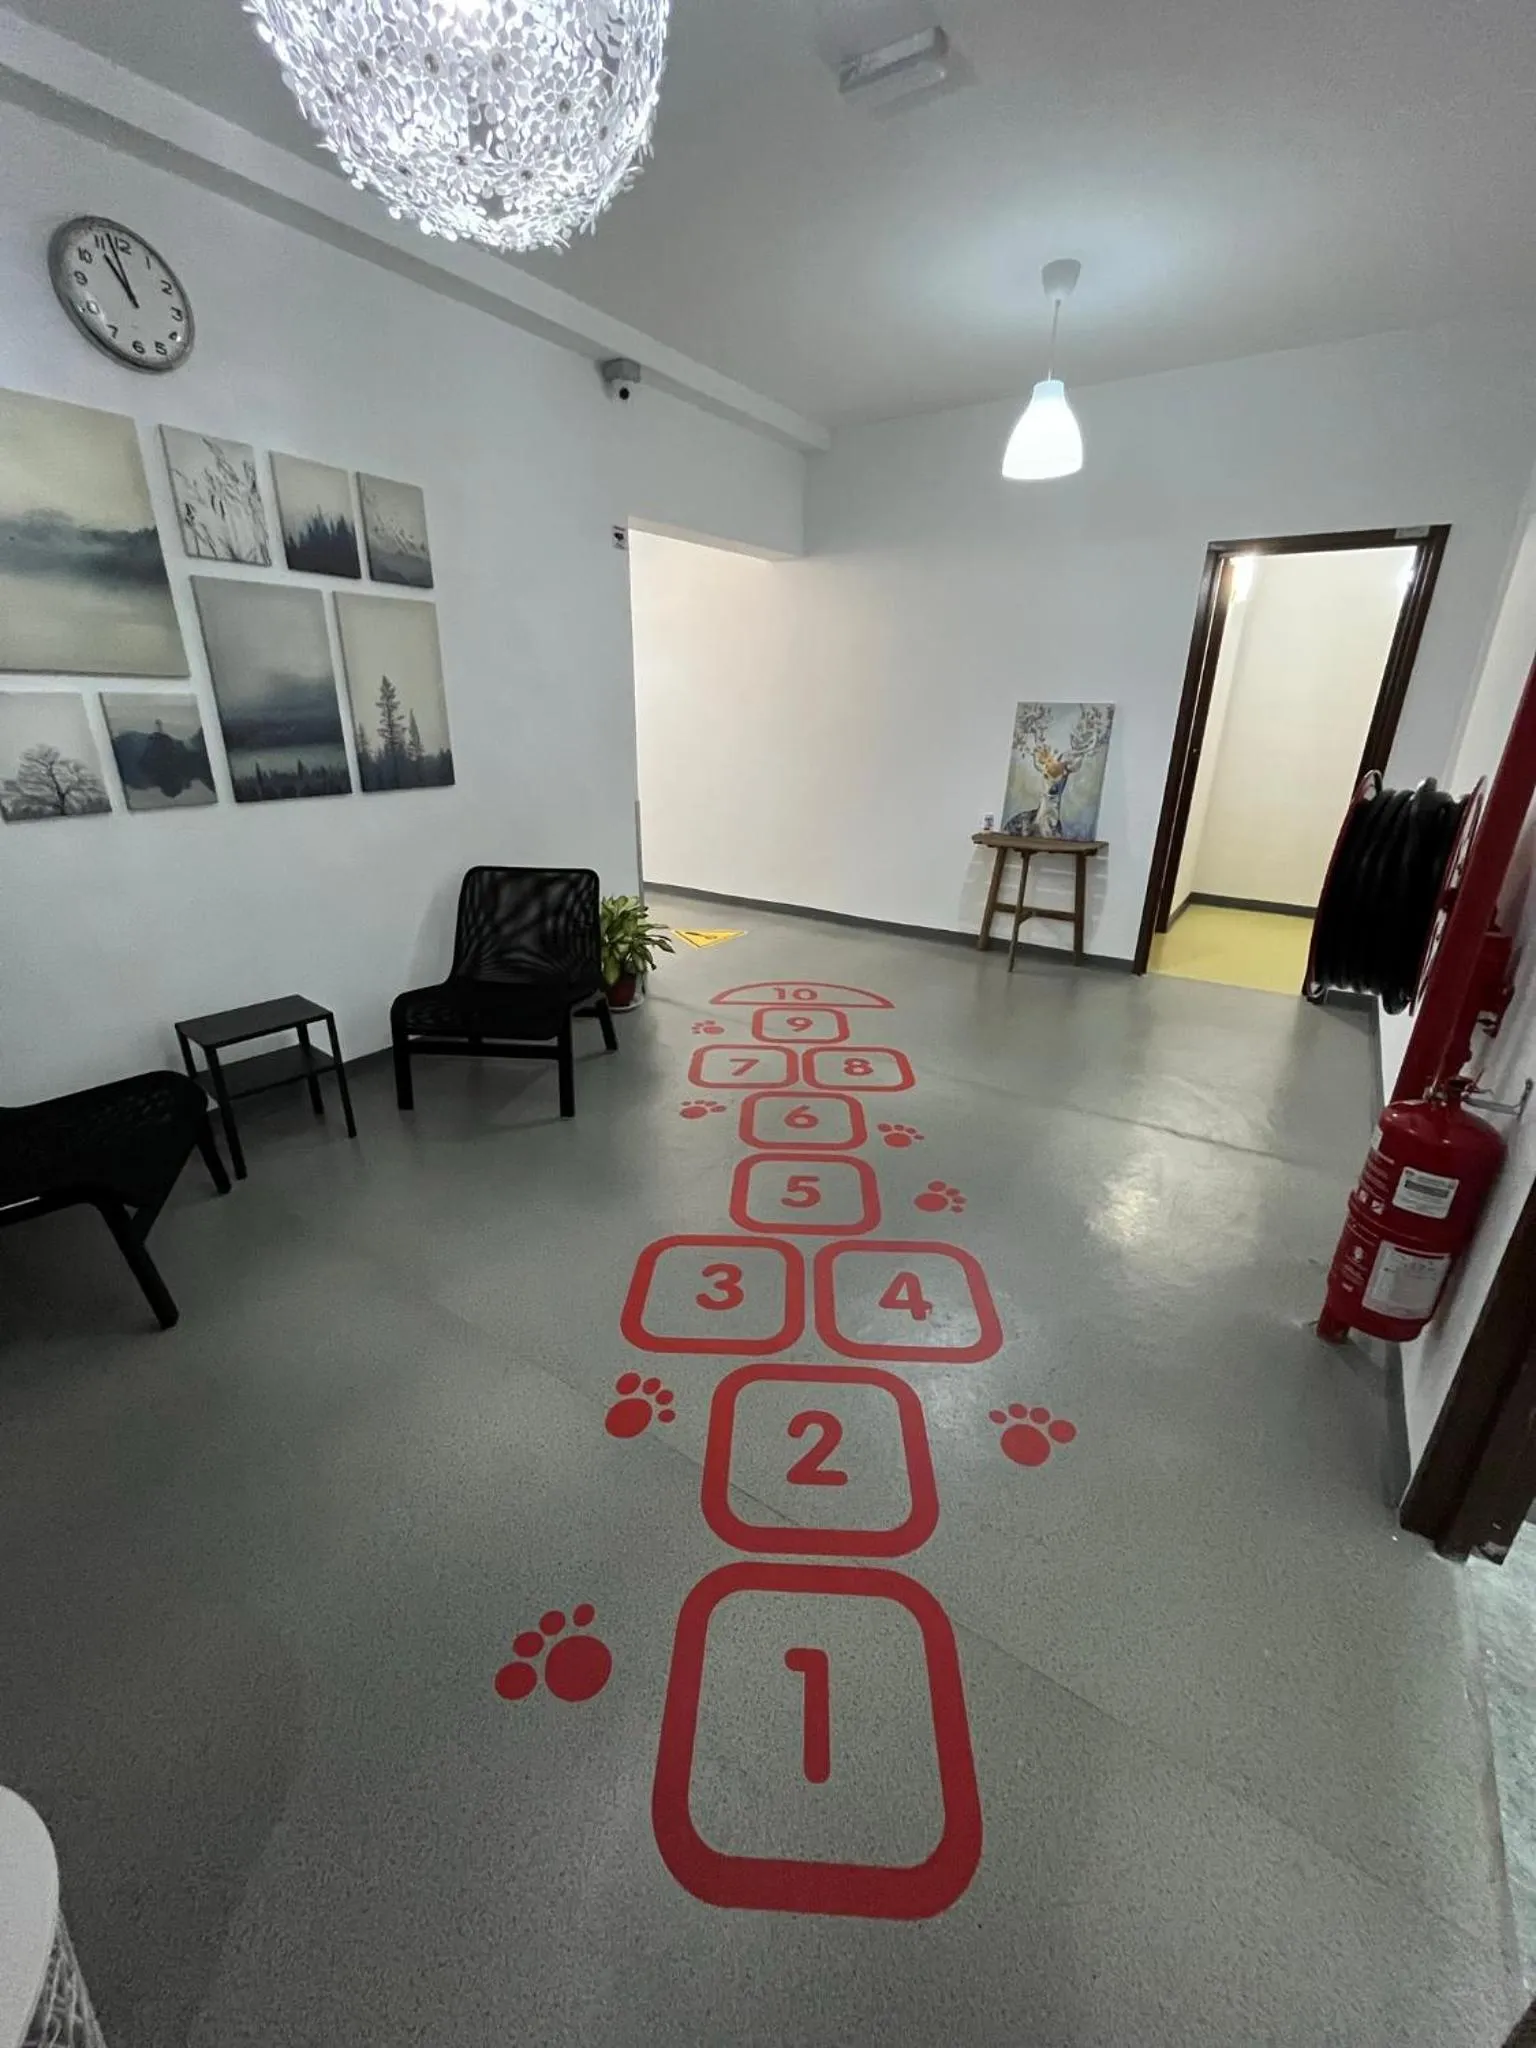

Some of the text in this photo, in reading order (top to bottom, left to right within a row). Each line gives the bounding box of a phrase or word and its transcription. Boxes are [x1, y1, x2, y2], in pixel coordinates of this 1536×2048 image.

[115, 236, 132, 255] 12
[78, 247, 93, 264] 10
[145, 256, 151, 270] 1
[74, 270, 88, 286] 9
[161, 280, 173, 295] 2
[171, 307, 183, 322] 3
[107, 325, 119, 339] 7
[132, 340, 146, 354] 6
[154, 341, 167, 356] 5
[772, 987, 818, 1001] 10
[786, 1017, 813, 1032] 9
[728, 1058, 760, 1077] 7
[843, 1058, 874, 1077] 8
[784, 1105, 819, 1129] 6
[782, 1175, 821, 1209] 5
[696, 1263, 744, 1311] 3
[878, 1271, 933, 1321] 4
[786, 1409, 848, 1487] 2
[784, 1647, 831, 1785] 1
